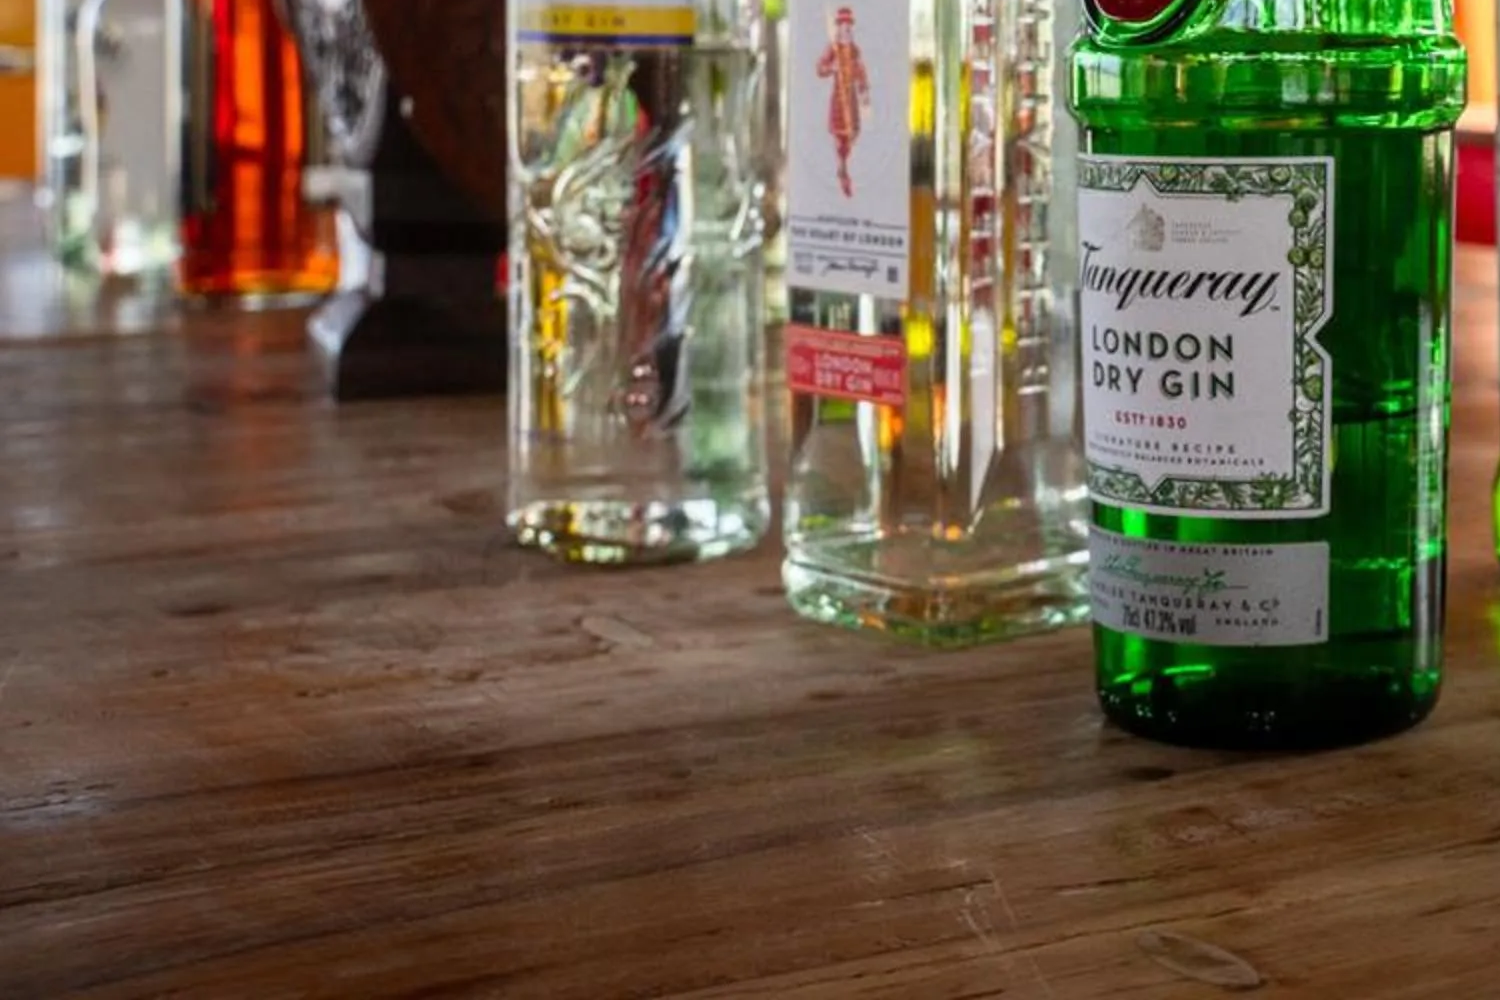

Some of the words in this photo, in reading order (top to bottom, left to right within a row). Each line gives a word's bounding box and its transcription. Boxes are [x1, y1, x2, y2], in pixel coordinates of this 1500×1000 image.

[1081, 240, 1281, 318] Tanqueray
[1092, 324, 1234, 362] LONDON
[1092, 361, 1144, 394] DRY
[1160, 369, 1236, 400] GIN
